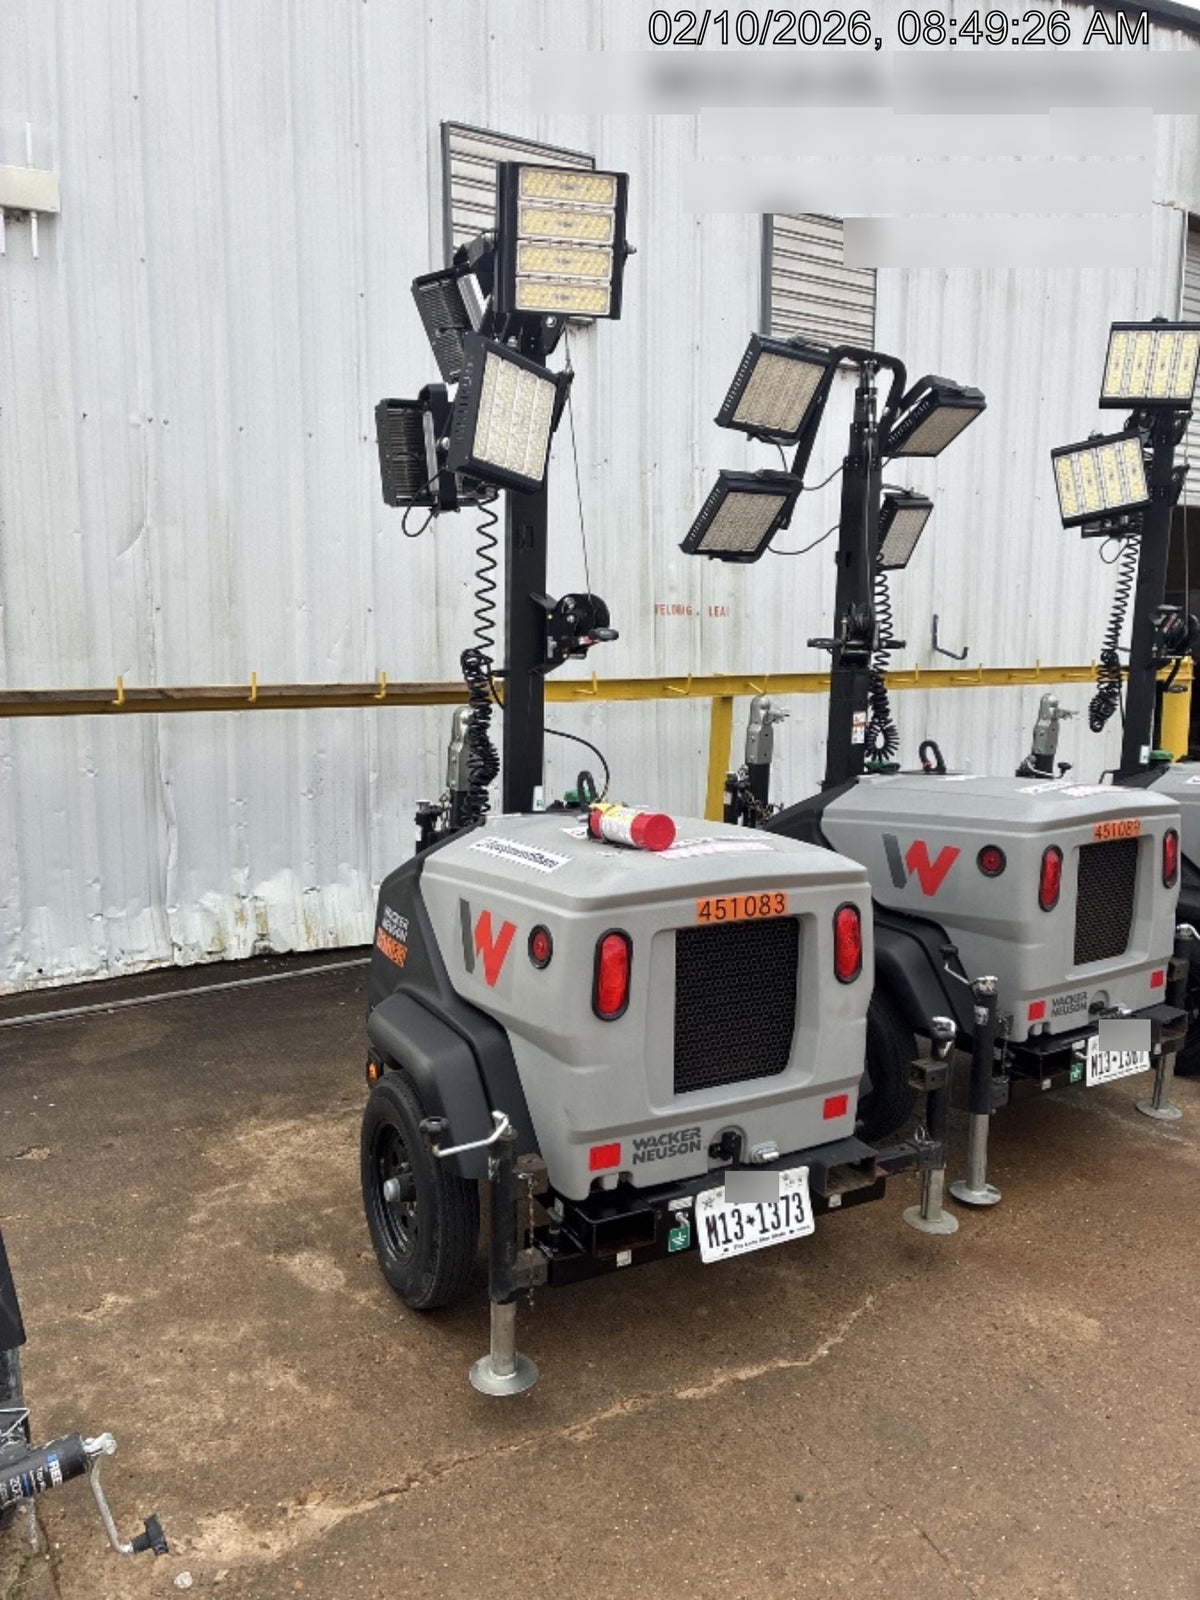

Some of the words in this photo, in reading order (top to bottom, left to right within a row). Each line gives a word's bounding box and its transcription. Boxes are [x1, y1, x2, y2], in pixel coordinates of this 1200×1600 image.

[698, 892, 786, 921] 451083
[632, 1126, 702, 1151] WACKER
[632, 1139, 702, 1166] NEUSON
